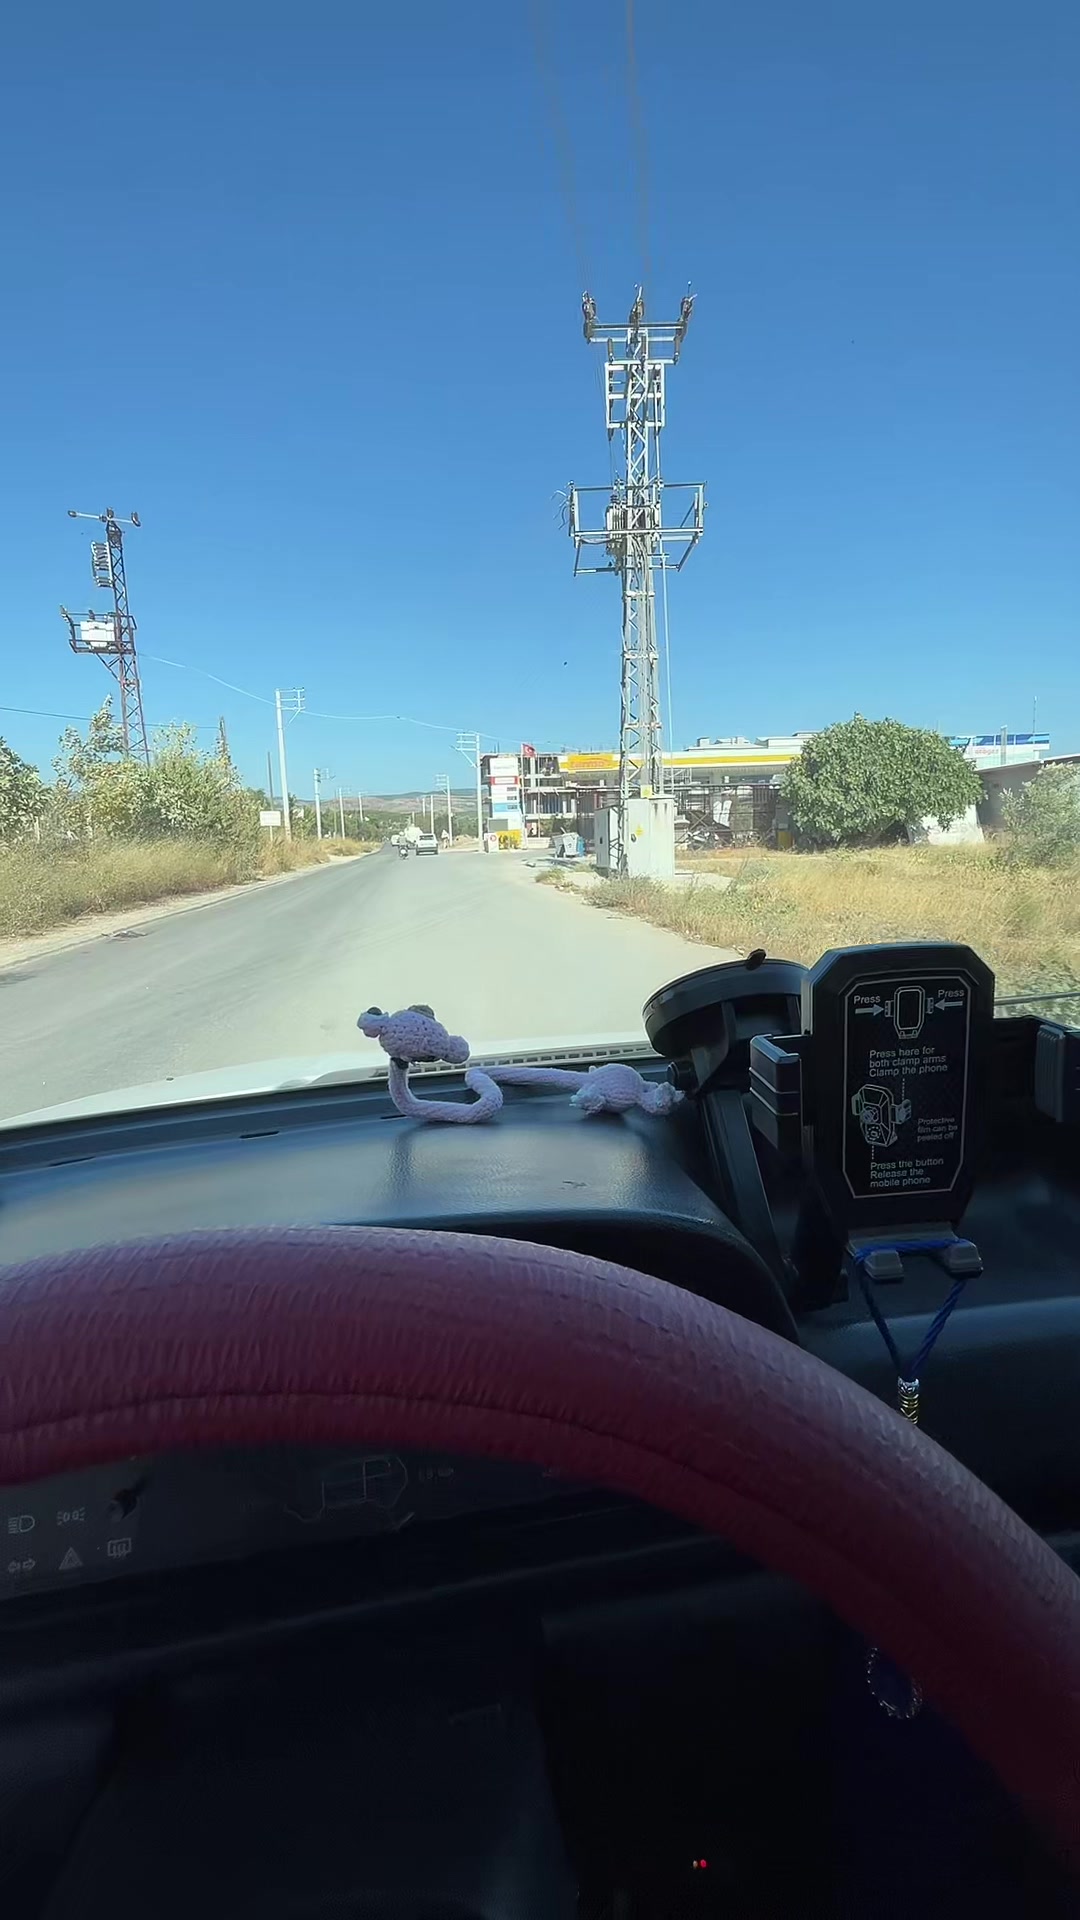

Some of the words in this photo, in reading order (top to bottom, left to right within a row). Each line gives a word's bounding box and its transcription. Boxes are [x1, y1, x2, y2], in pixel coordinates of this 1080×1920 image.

[937, 989, 965, 998] Press
[853, 995, 881, 1004] Press
[869, 1049, 896, 1059] Press
[899, 1048, 920, 1056] here
[922, 1046, 935, 1054] for
[869, 1059, 889, 1068] both
[892, 1056, 920, 1067] clamp
[922, 1055, 946, 1064] arms
[869, 1068, 899, 1077] Clamp
[902, 1065, 916, 1074] the
[919, 1063, 948, 1074] phone
[917, 1117, 955, 1125] Protective
[917, 1133, 942, 1142] peeled
[944, 1131, 954, 1139] off
[870, 1162, 896, 1170] Press
[898, 1160, 913, 1168] the
[915, 1158, 944, 1167] button
[870, 1171, 907, 1179] Release
[909, 1168, 924, 1176] the
[870, 1179, 900, 1187] mobile
[902, 1177, 931, 1187] phone
